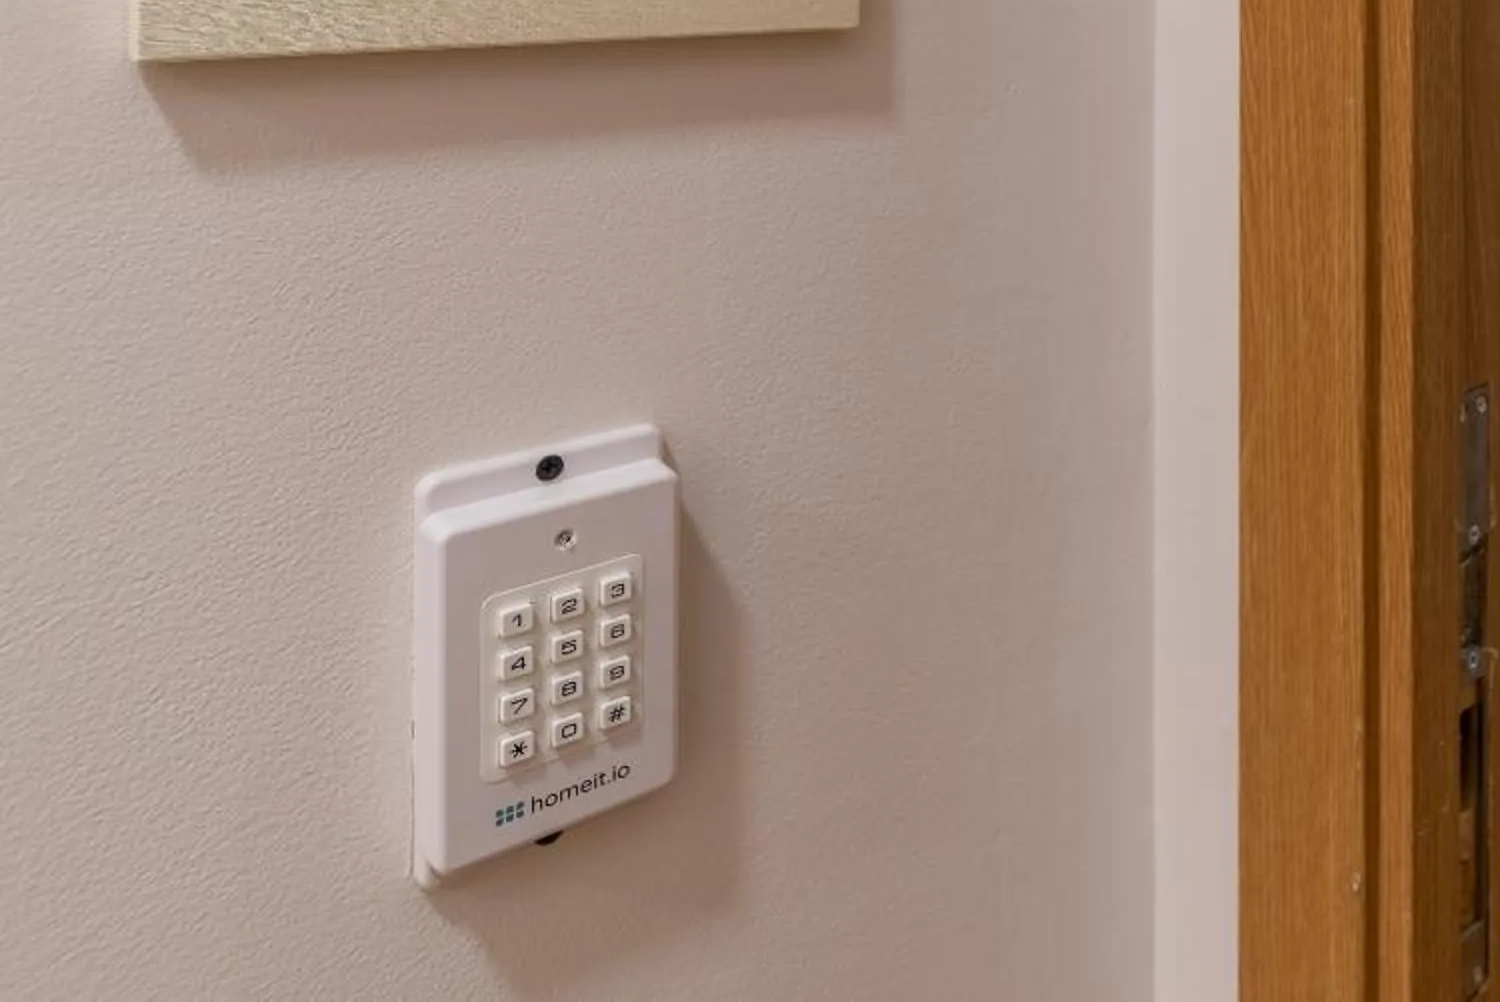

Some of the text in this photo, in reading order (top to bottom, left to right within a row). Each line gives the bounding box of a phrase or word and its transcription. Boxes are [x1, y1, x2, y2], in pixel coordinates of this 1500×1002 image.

[511, 582, 625, 628] 1 2 3
[511, 623, 625, 672] 4 5 6
[510, 664, 625, 715] 7 8 9
[530, 764, 632, 815] homeit.io
